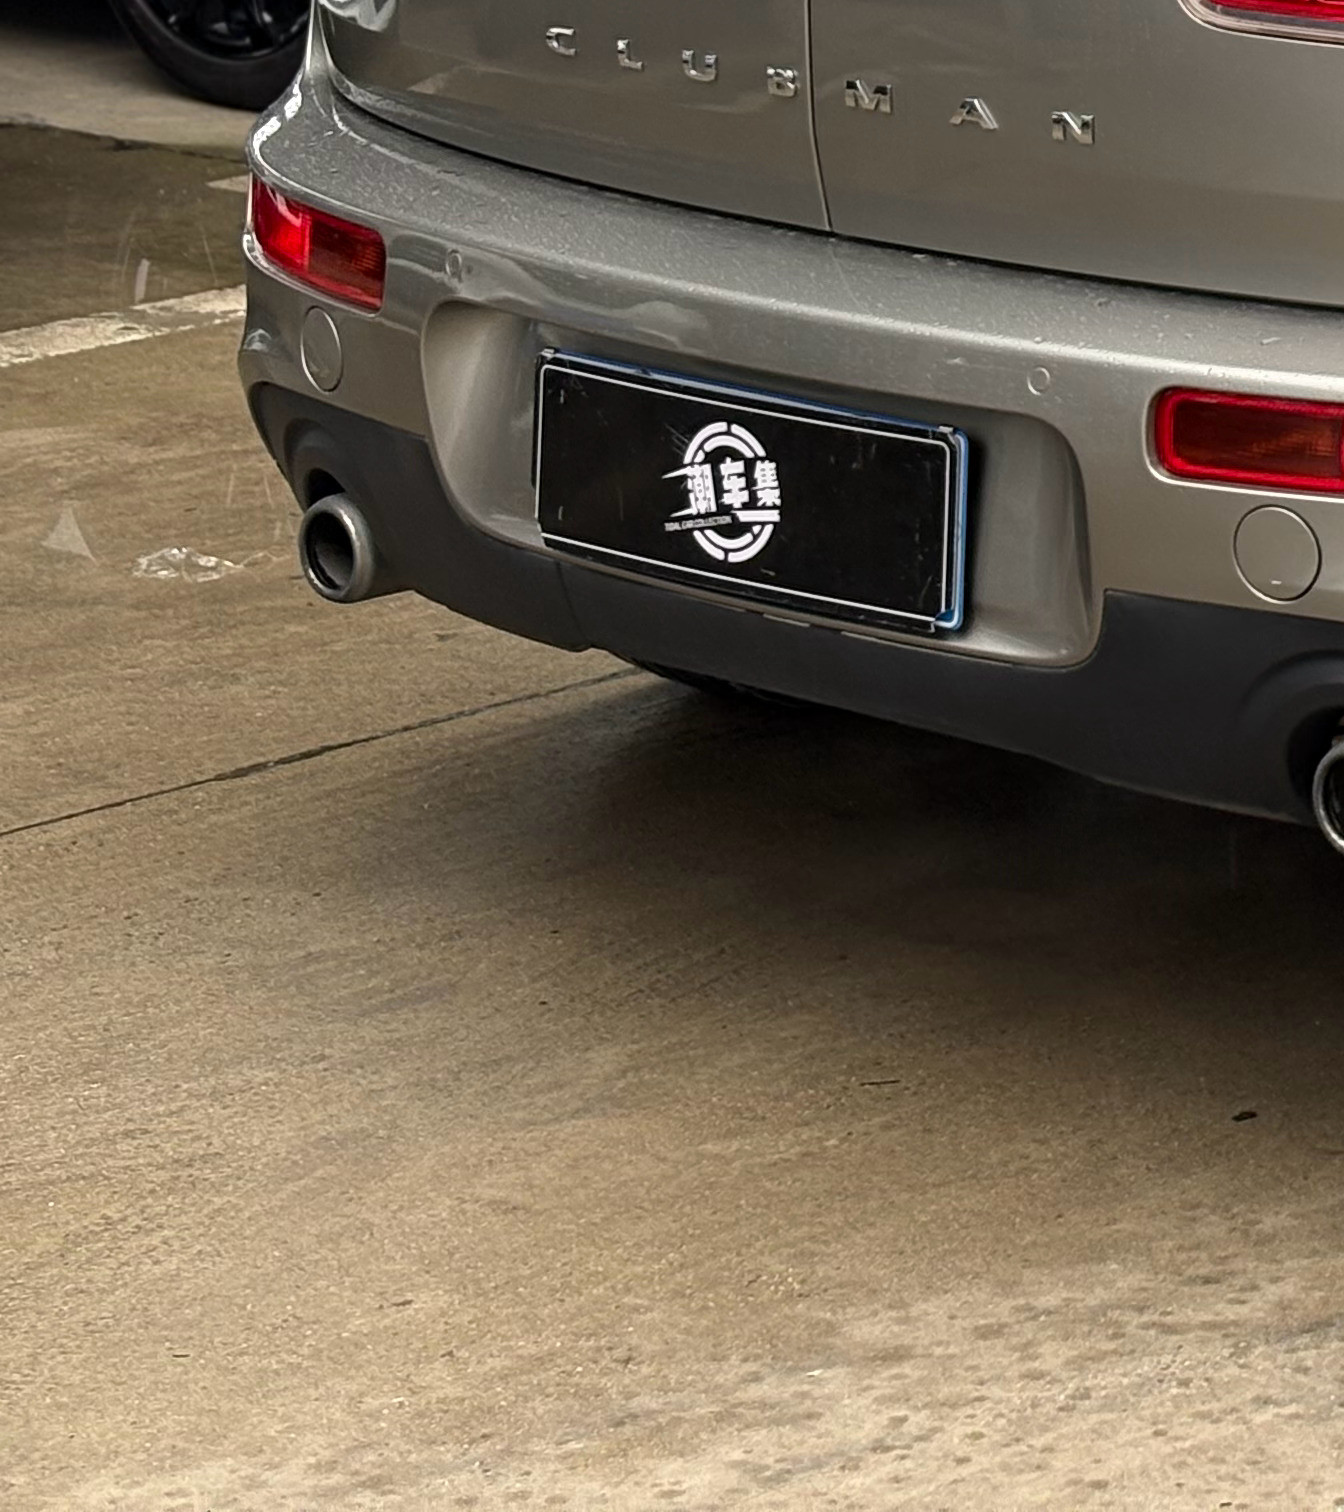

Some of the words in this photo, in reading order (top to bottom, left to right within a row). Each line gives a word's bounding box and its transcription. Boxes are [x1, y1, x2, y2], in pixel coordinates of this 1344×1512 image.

[544, 24, 1097, 145] CLUBMAN
[664, 457, 782, 515] 潮车集
